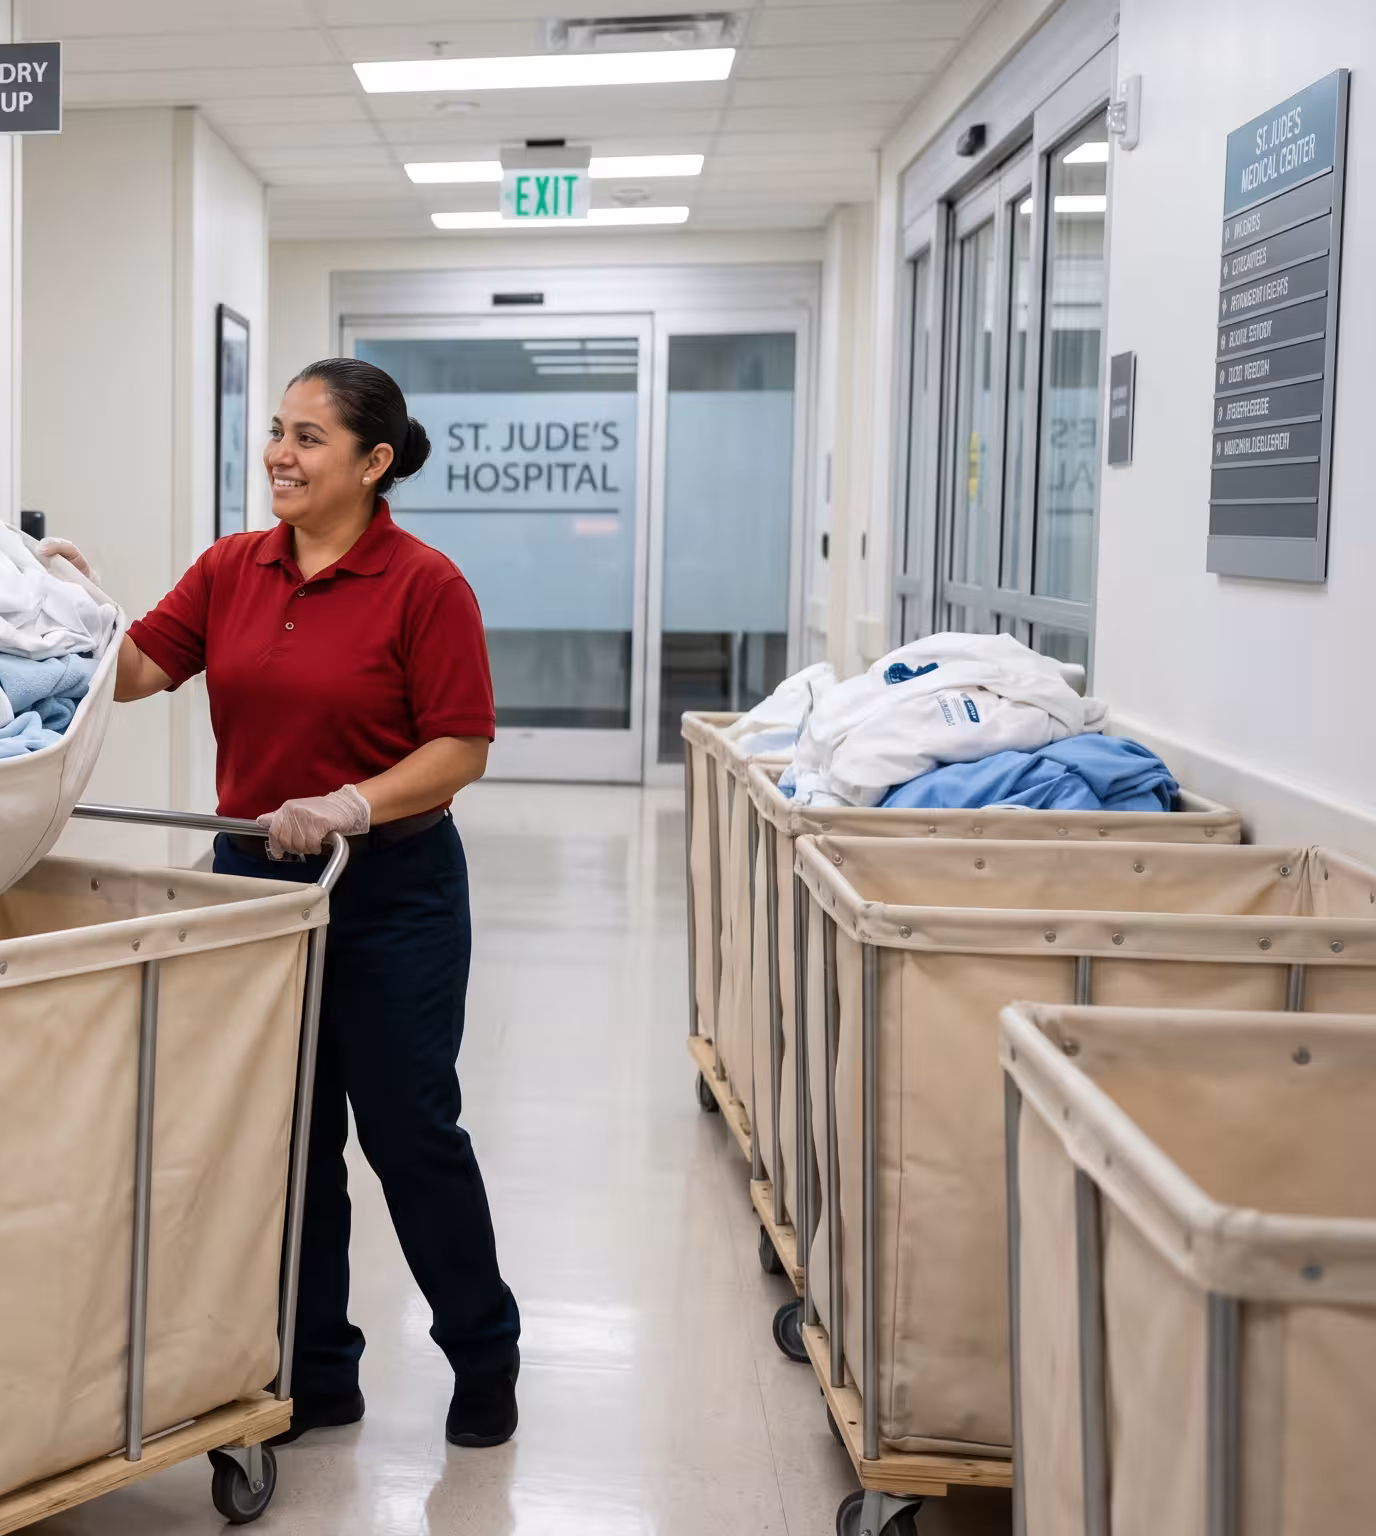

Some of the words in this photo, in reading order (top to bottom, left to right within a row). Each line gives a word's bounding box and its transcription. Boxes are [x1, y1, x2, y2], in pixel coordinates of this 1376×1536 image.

[1255, 124, 1269, 155] ST.
[1269, 106, 1302, 148] JUDE'S
[1241, 153, 1278, 194] MEDICAL
[1279, 133, 1316, 175] CENTER
[516, 174, 579, 216] EXIT
[447, 421, 492, 452] ST.
[501, 421, 620, 452] JUDE'S
[446, 462, 620, 493] HOSPITAL
